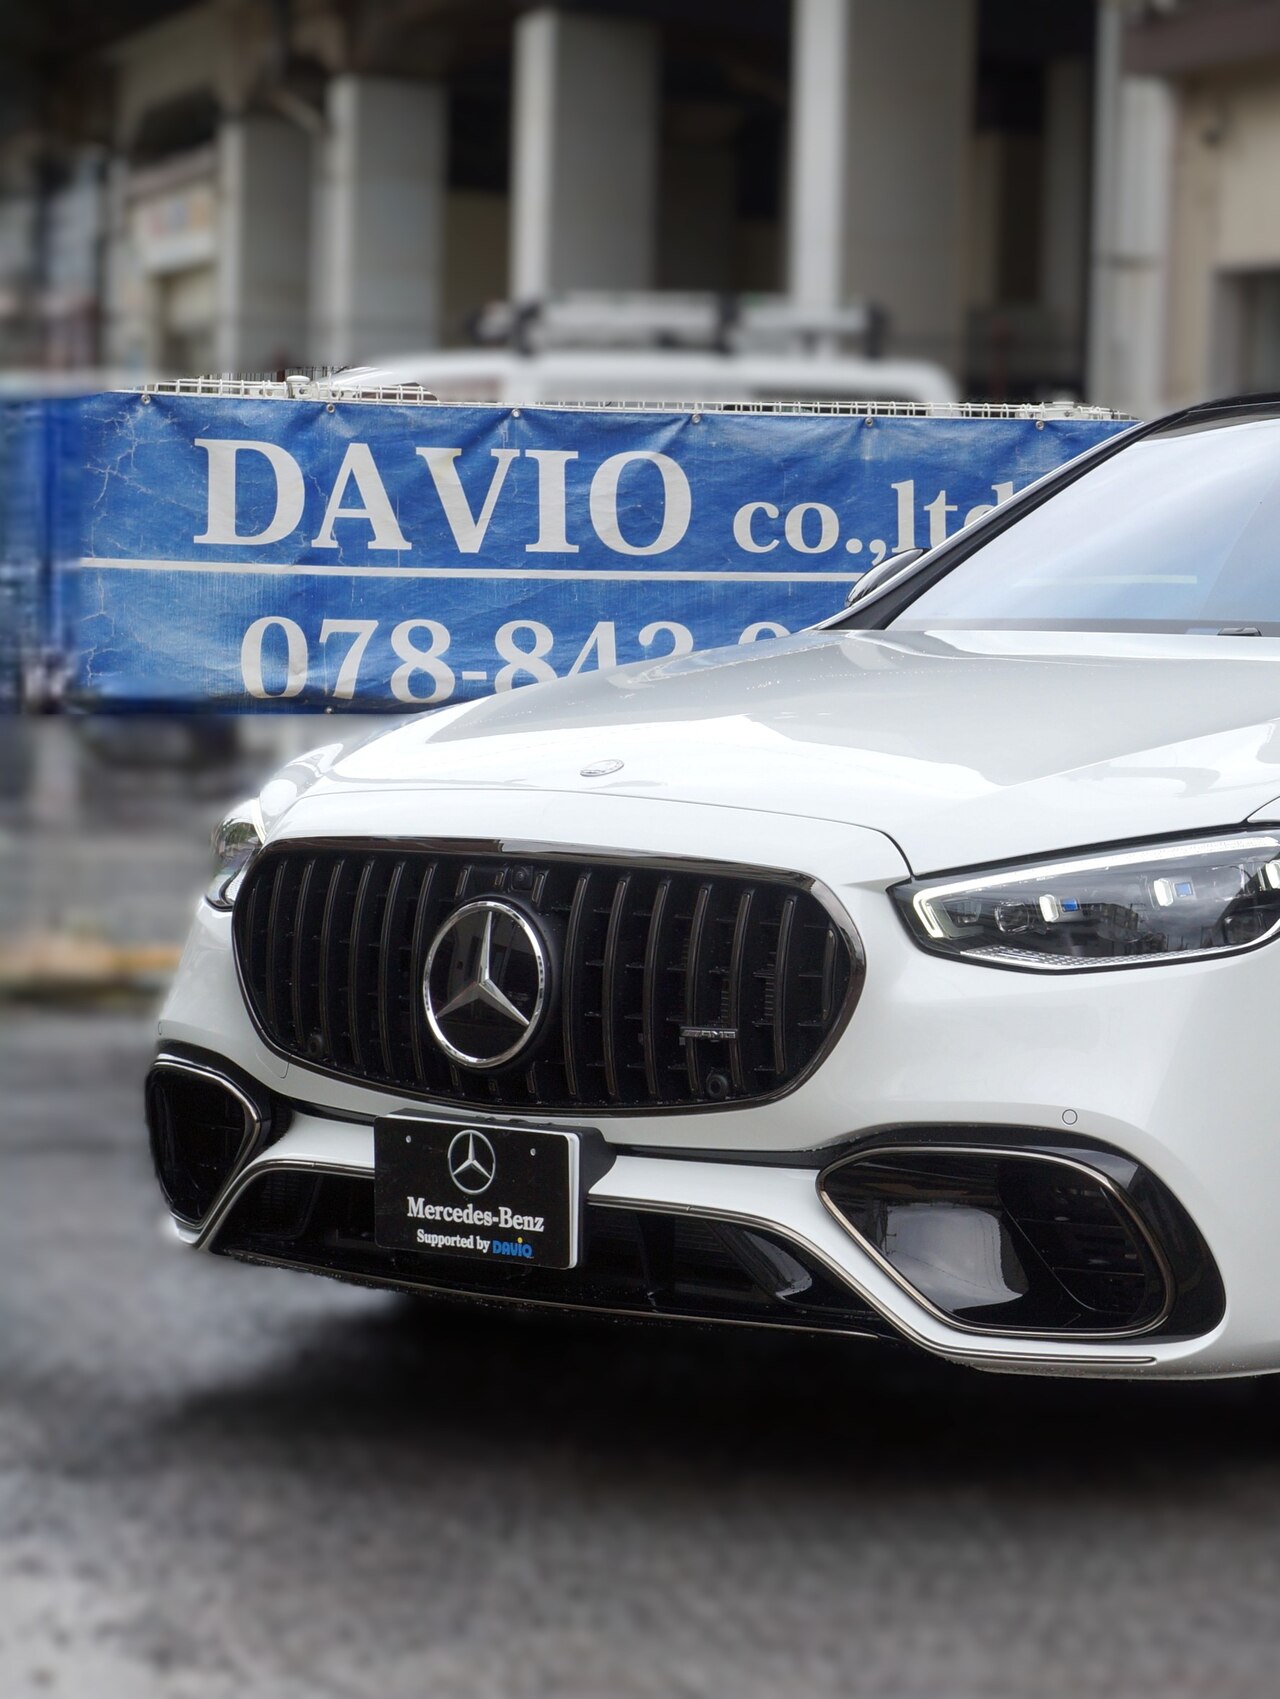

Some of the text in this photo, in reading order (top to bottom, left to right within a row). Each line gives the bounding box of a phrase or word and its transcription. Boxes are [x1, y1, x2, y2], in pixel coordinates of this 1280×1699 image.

[193, 438, 693, 556] DAVIO
[406, 1196, 545, 1232] Mercedes-Benz
[416, 1229, 474, 1248] Supported
[476, 1236, 491, 1253] by
